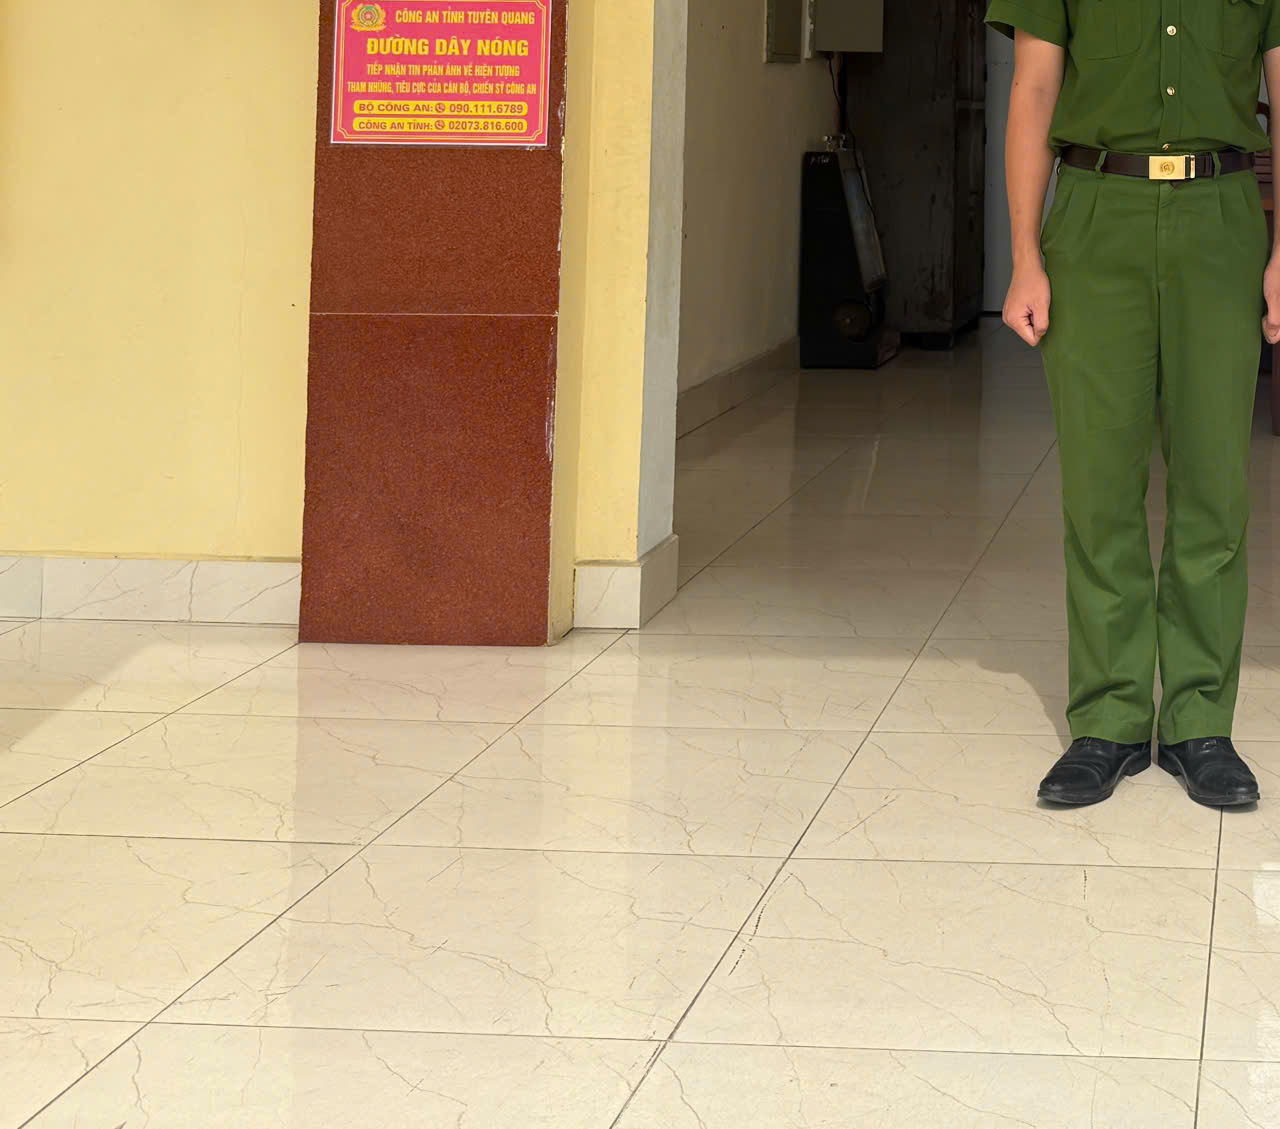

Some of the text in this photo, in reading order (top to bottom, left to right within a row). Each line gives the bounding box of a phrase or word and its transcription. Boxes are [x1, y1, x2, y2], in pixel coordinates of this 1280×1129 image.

[395, 6, 535, 25] CÔNG AN TỈNH TUYÊN QUANG
[367, 34, 529, 56] ĐƯỜNG DÂY NÓNG
[359, 102, 523, 114] BỘ CÔNG AN: 090.111.6789
[358, 119, 524, 131] CÔNG AN TỈNH: 02073.816.600
